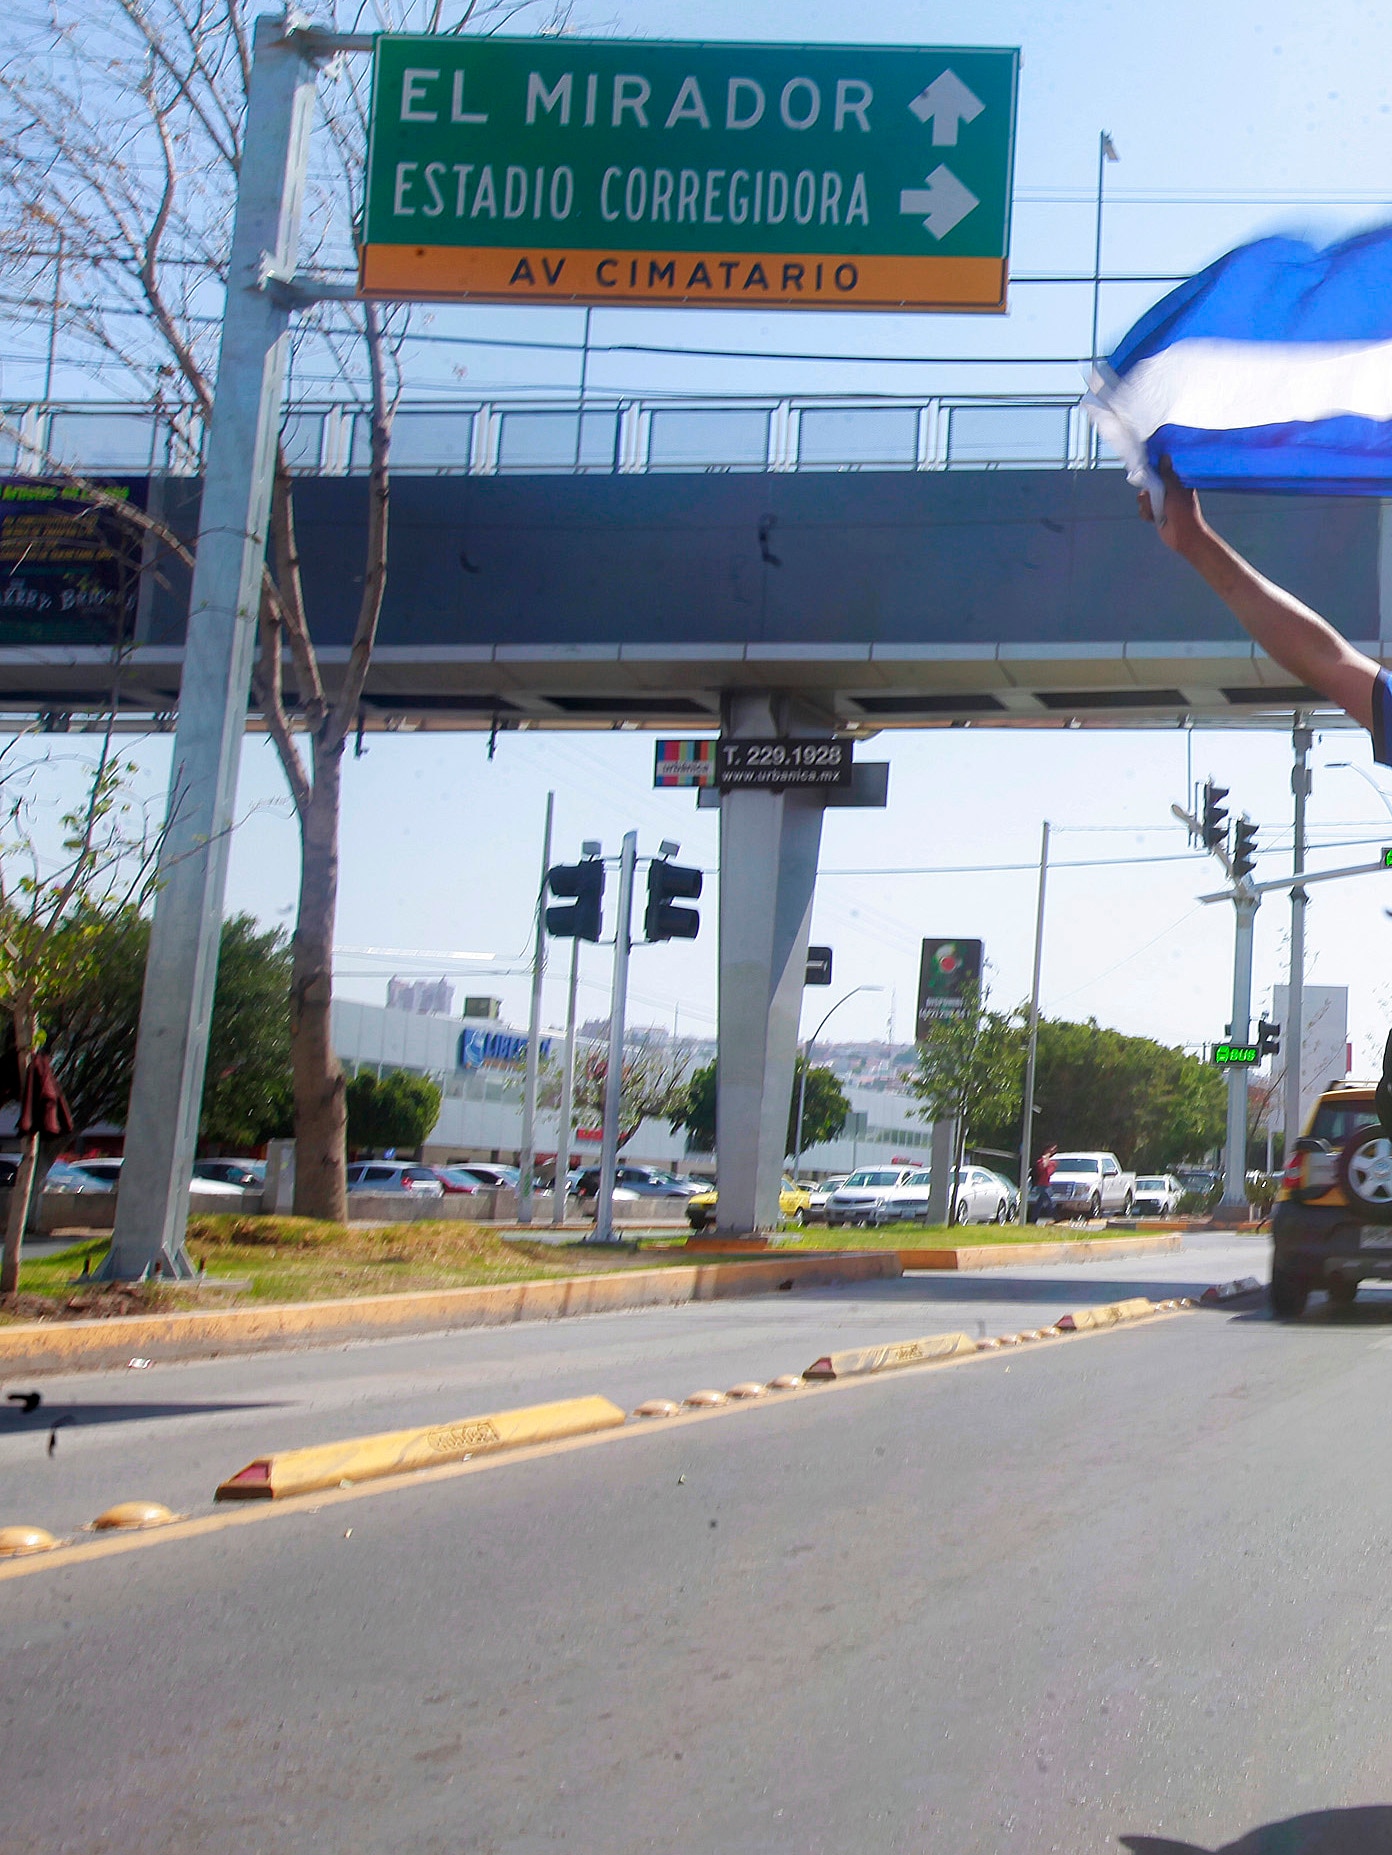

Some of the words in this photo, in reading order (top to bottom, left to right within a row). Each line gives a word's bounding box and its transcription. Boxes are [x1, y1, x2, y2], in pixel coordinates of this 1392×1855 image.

[400, 68, 489, 123] EL
[525, 72, 873, 132] MIRADOR
[393, 161, 574, 220] ESTADIO
[600, 165, 870, 226] CORREGIDORA
[509, 257, 568, 288] AV
[595, 259, 859, 292] CIMATARIO
[723, 745, 741, 766] T.
[746, 745, 843, 766] 229.1928
